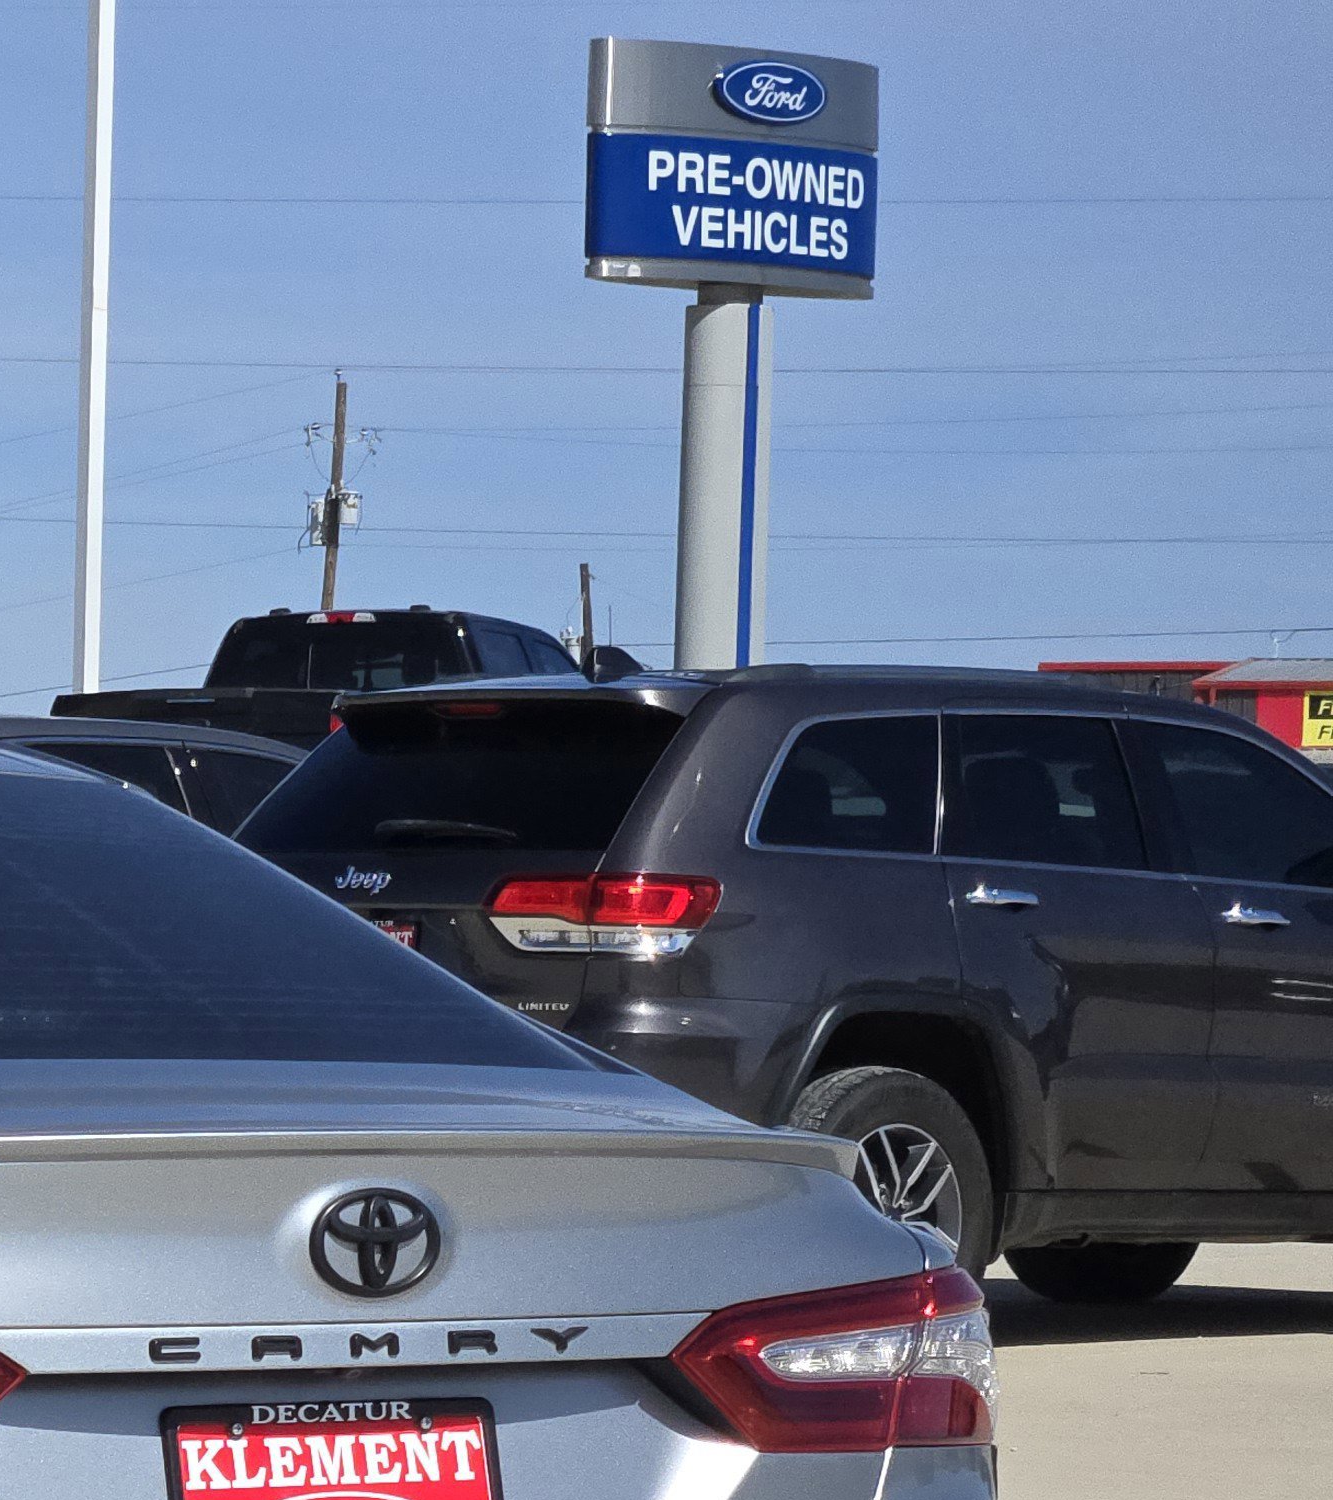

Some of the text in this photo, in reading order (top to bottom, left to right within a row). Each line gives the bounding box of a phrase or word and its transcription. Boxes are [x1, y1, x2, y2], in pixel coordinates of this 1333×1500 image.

[744, 73, 807, 112] Ford
[648, 150, 864, 209] PRE-OWNED
[672, 205, 848, 260] VEHICLES
[335, 865, 392, 896] Jeep
[148, 1326, 589, 1364] CAMRY
[251, 1401, 412, 1425] DECATUR
[181, 1430, 481, 1490] KLEMENT
